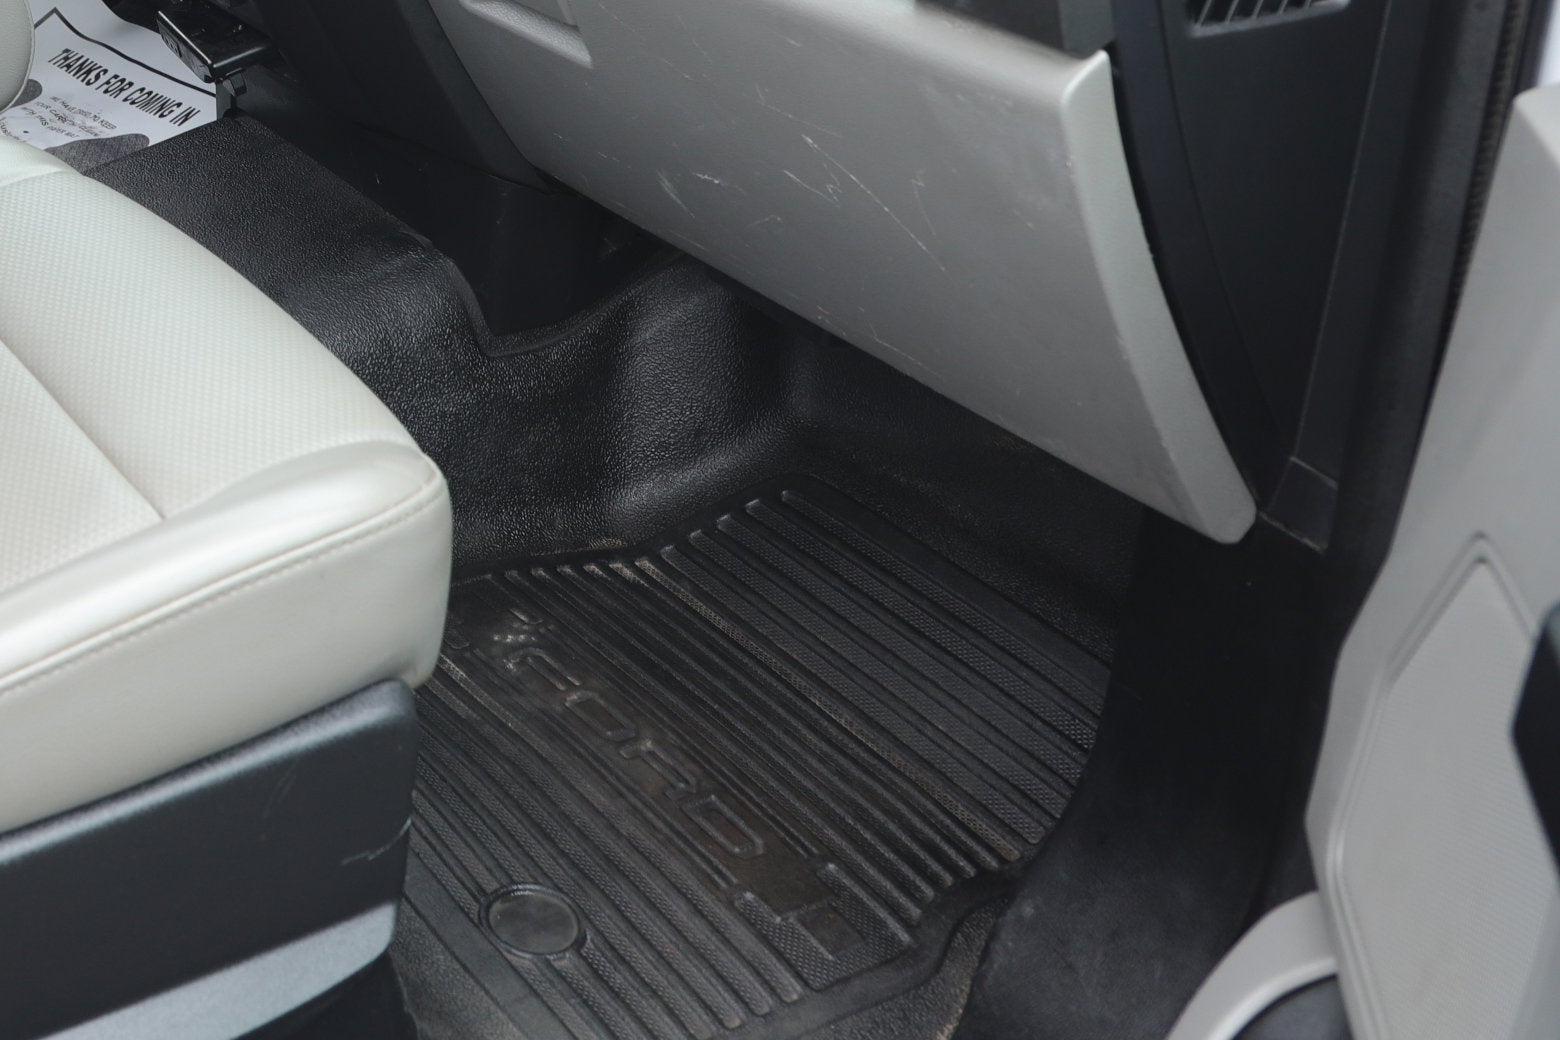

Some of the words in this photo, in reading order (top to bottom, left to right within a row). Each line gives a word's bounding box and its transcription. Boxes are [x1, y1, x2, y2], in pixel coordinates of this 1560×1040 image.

[47, 47, 109, 87] THANKS
[94, 73, 135, 99] FOR
[121, 86, 184, 119] COMING
[168, 105, 202, 128] IN
[498, 646, 765, 859] FORD
